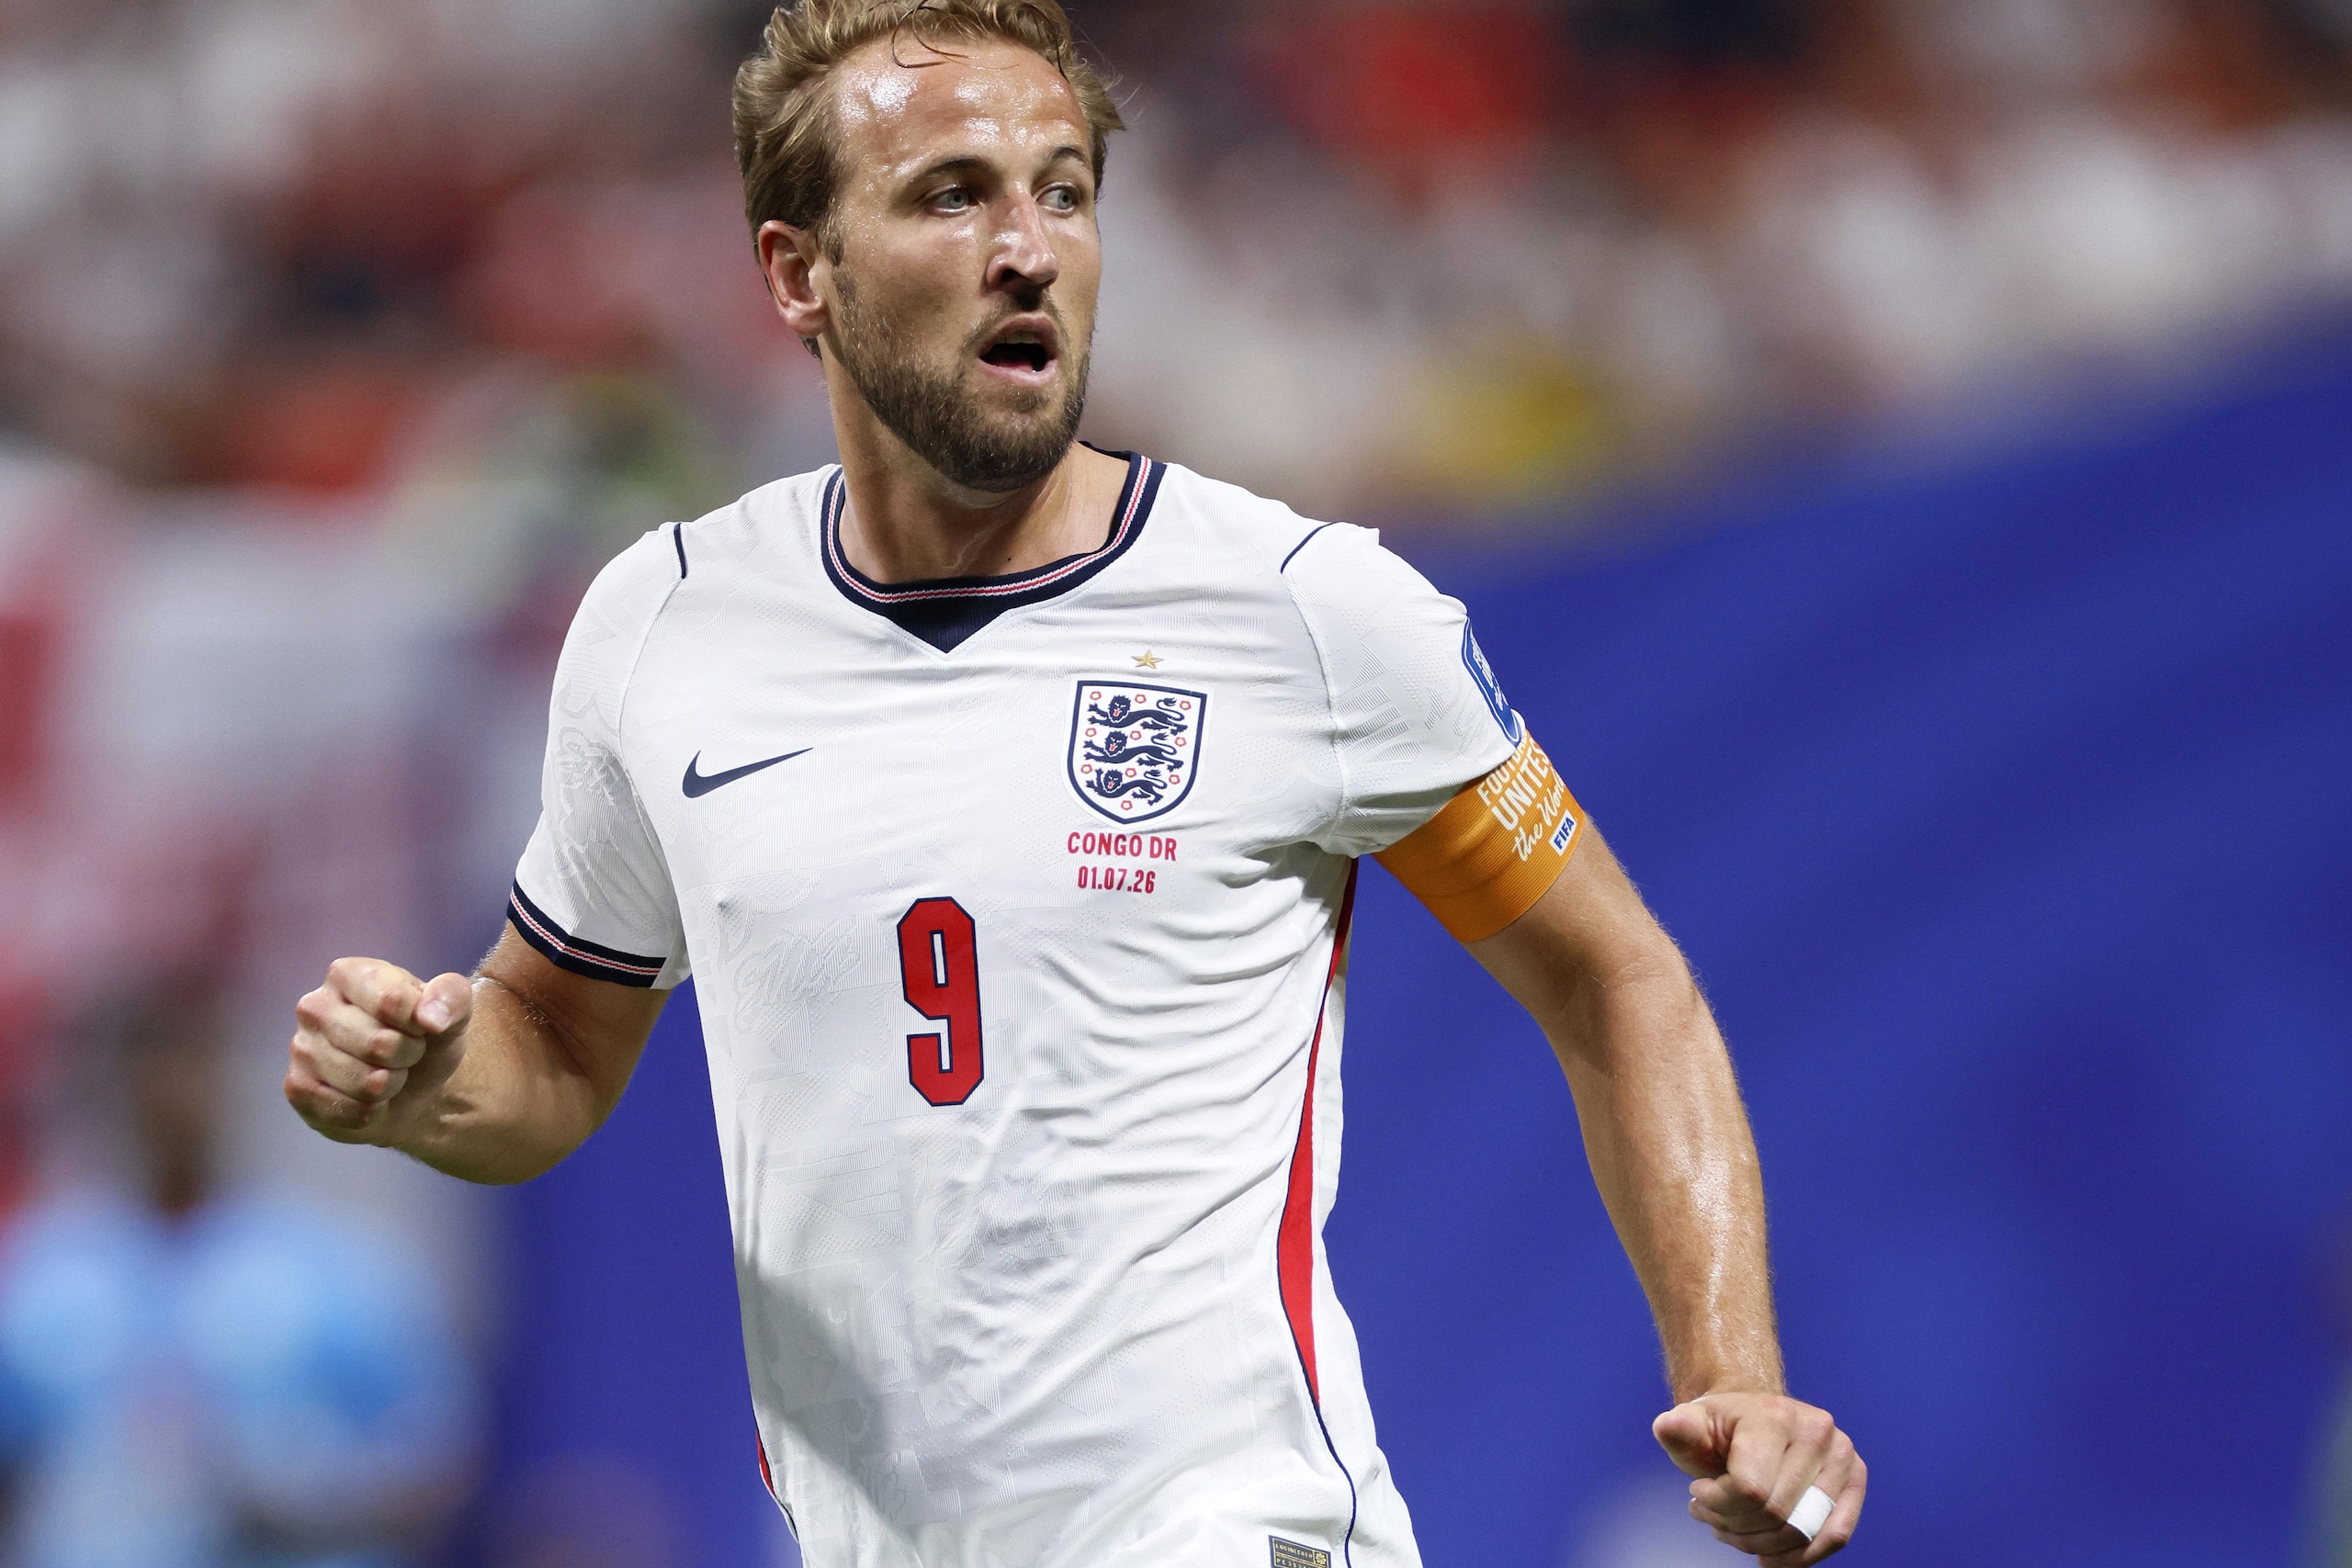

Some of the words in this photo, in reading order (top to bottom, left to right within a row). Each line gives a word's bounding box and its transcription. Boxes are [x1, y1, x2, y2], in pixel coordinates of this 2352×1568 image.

[1476, 728, 1527, 807] FOOT
[1491, 737, 1550, 831] UNITES
[1067, 831, 1143, 858] CONGO
[1149, 836, 1177, 862] DR
[1511, 822, 1544, 862] the
[1554, 817, 1575, 850] FIFA
[1078, 865, 1156, 894] 01.07.26
[897, 896, 984, 1107] 9
